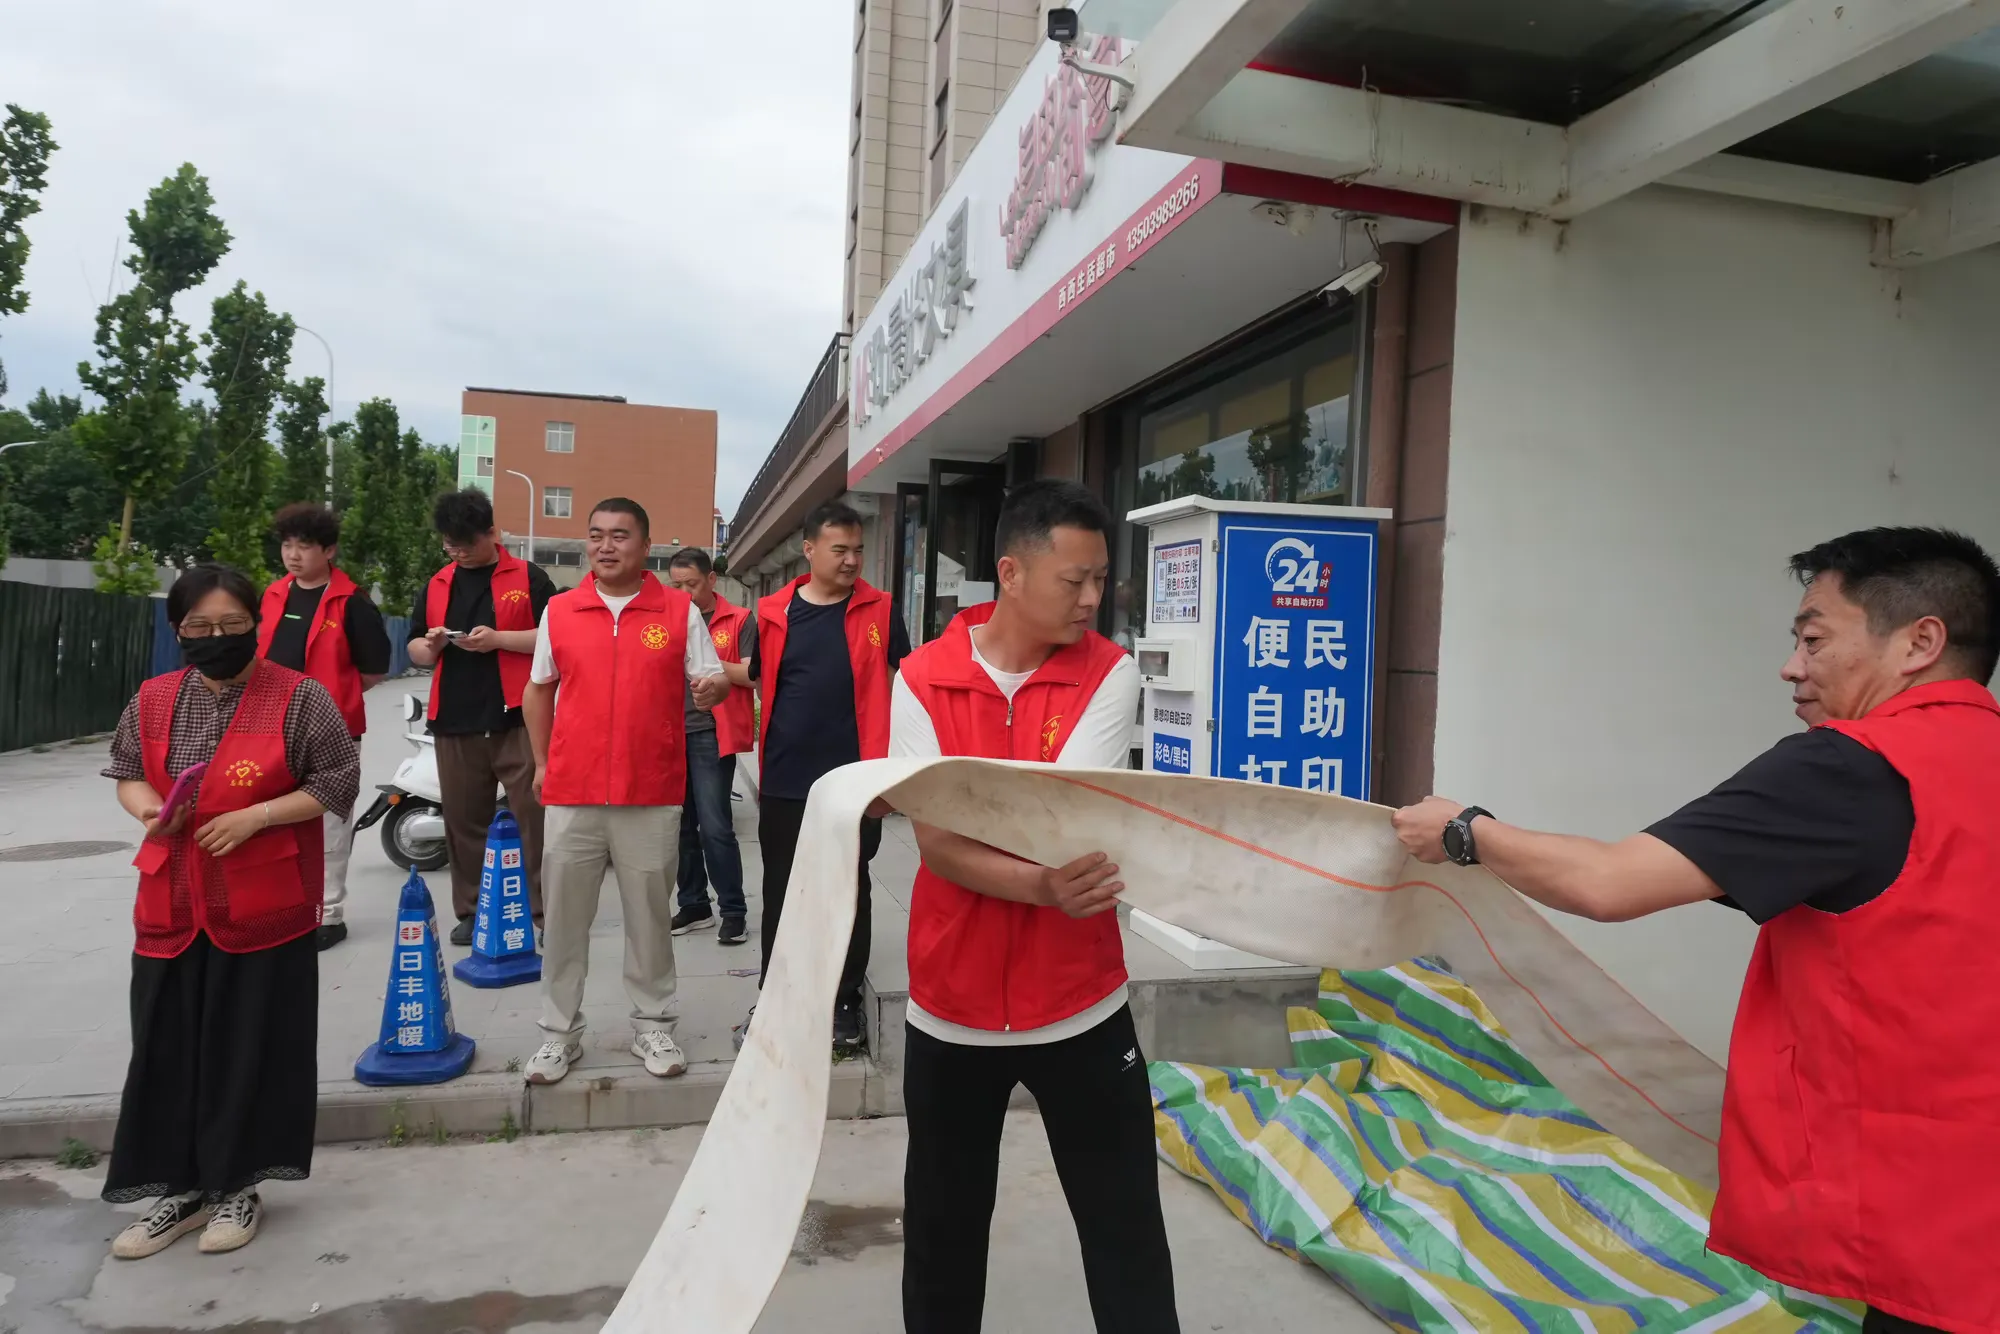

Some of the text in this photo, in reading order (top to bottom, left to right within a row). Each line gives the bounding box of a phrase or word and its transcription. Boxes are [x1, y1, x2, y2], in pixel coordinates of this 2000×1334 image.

[1126, 174, 1199, 252] 13503989266
[1272, 559, 1331, 593] 24 小时
[1276, 597, 1324, 608] 共享自助打印
[1242, 615, 1347, 670] 便民
[1247, 685, 1345, 738] 自助
[1155, 743, 1189, 769] 彩色/黑白
[1239, 755, 1343, 796] 打印
[502, 876, 524, 950] 日丰管
[398, 951, 424, 1047] 日丰地暖
